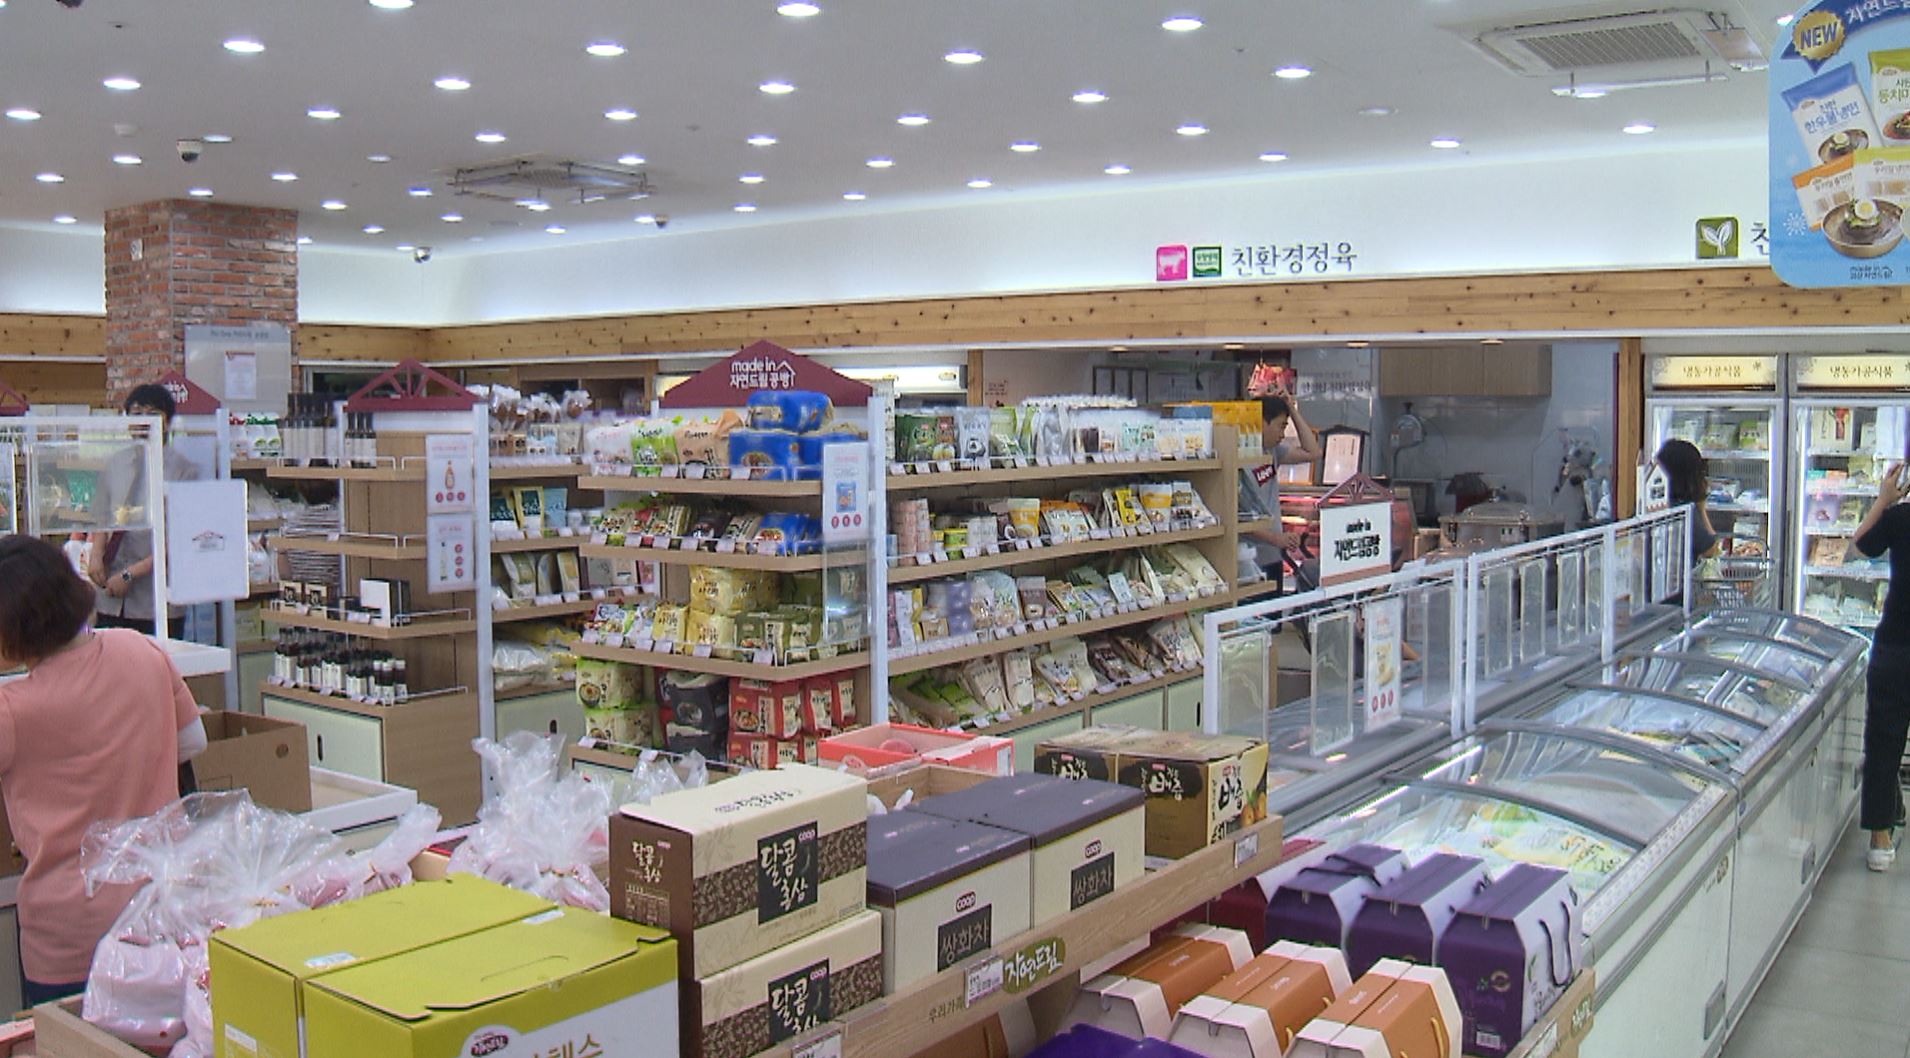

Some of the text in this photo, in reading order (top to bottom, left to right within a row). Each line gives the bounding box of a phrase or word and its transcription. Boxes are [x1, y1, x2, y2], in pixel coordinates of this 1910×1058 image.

[1799, 21, 1838, 50] NEW
[1231, 241, 1358, 276] 친환경정육
[729, 371, 768, 389] 자연드림
[731, 356, 776, 373] made in
[760, 838, 798, 885] 달콤
[780, 875, 810, 911] 홍삼
[1073, 867, 1113, 904] 쌍화차
[941, 919, 988, 964] 쌍화차
[1004, 940, 1064, 988] 자연드림
[771, 976, 808, 1027] 달콤
